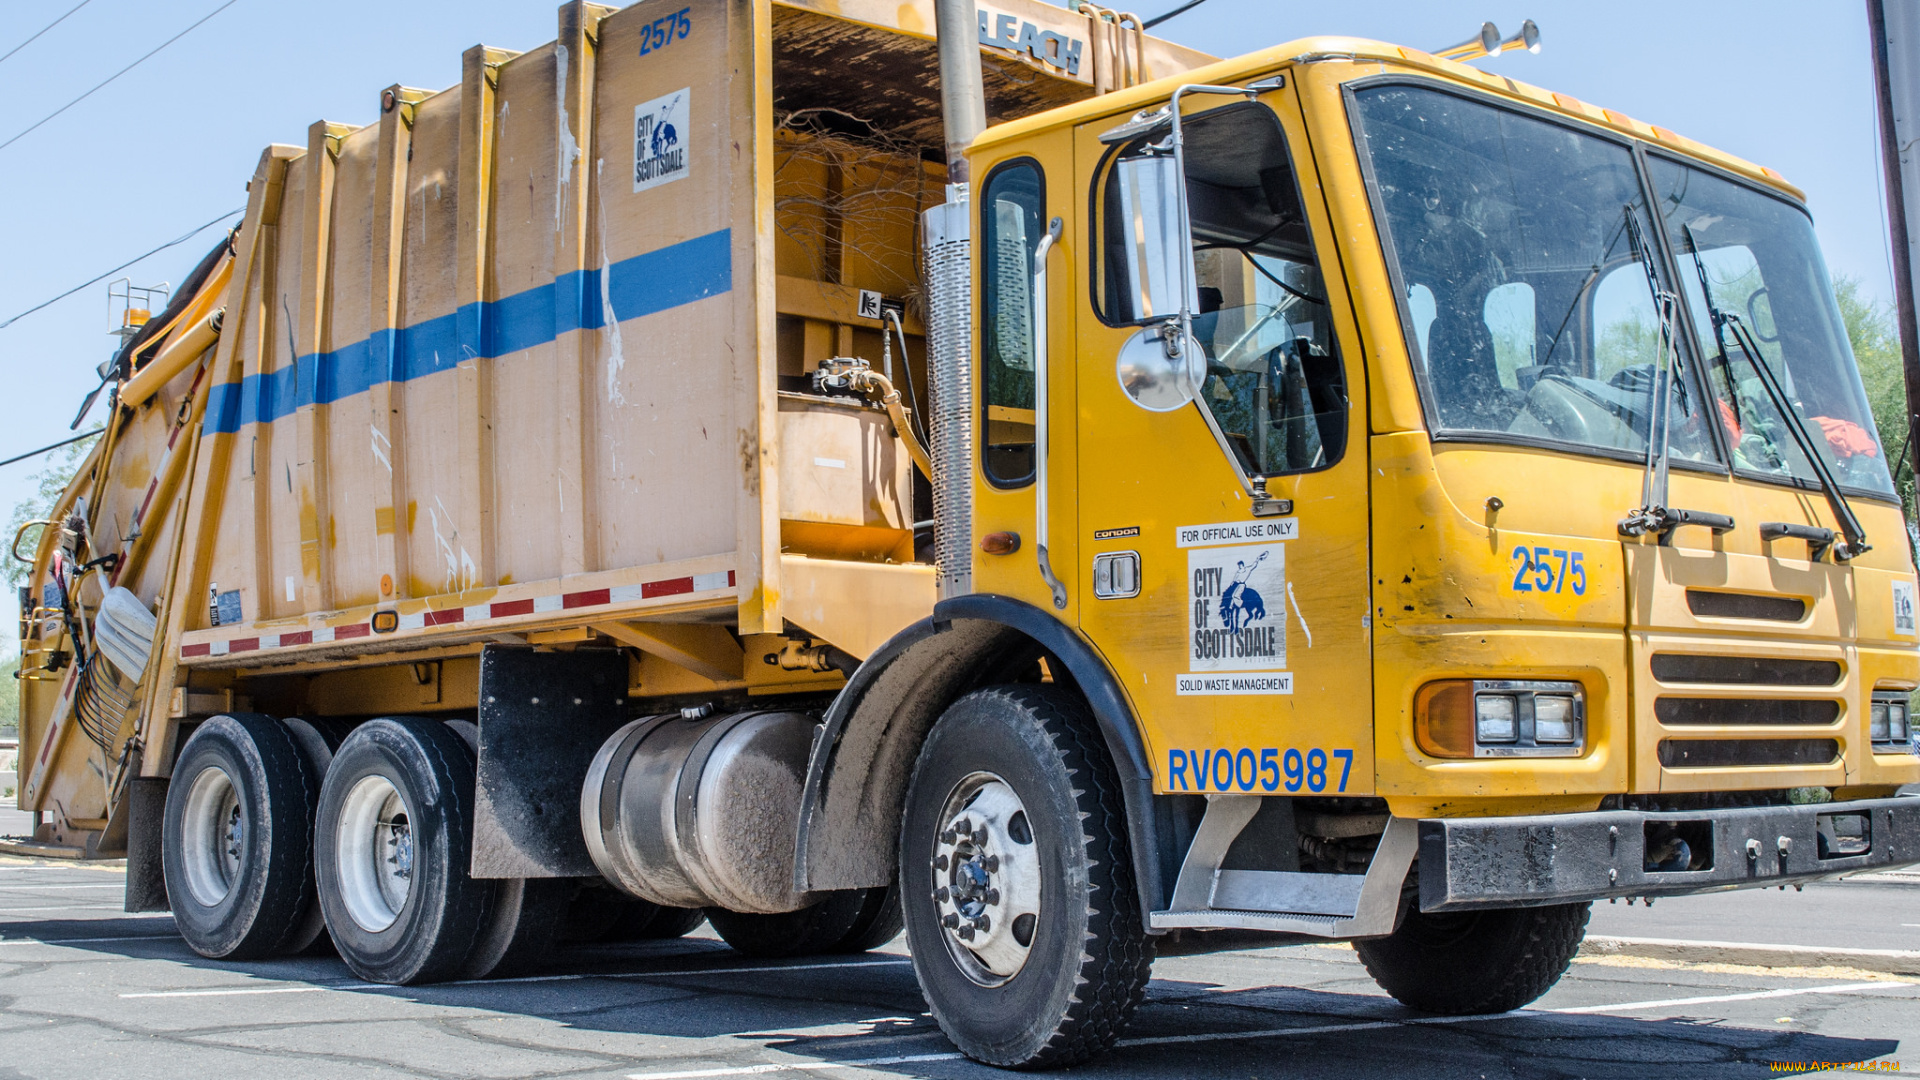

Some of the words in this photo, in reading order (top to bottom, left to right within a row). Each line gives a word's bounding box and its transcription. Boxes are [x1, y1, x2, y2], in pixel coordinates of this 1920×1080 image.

[639, 6, 691, 57] 2575
[977, 9, 1083, 75] LEACH
[637, 113, 654, 139] CITY
[636, 148, 683, 183] SCOTTSDALE
[637, 139, 646, 161] OF
[1095, 528, 1138, 538] CONDOR
[1181, 530, 1199, 542] FOR
[1202, 527, 1242, 541] OFFICIAL
[1245, 524, 1264, 537] USE
[1267, 522, 1292, 536] ONLY
[1194, 567, 1223, 598] CITY
[1512, 545, 1587, 597] 2575
[1194, 598, 1210, 629] OF
[1194, 626, 1276, 659] SCOTTSDALE
[1180, 679, 1203, 691] SOLID
[1204, 679, 1230, 691] WASTE
[1232, 678, 1289, 690] MANAGEMENT
[1168, 747, 1355, 793] RV005987
